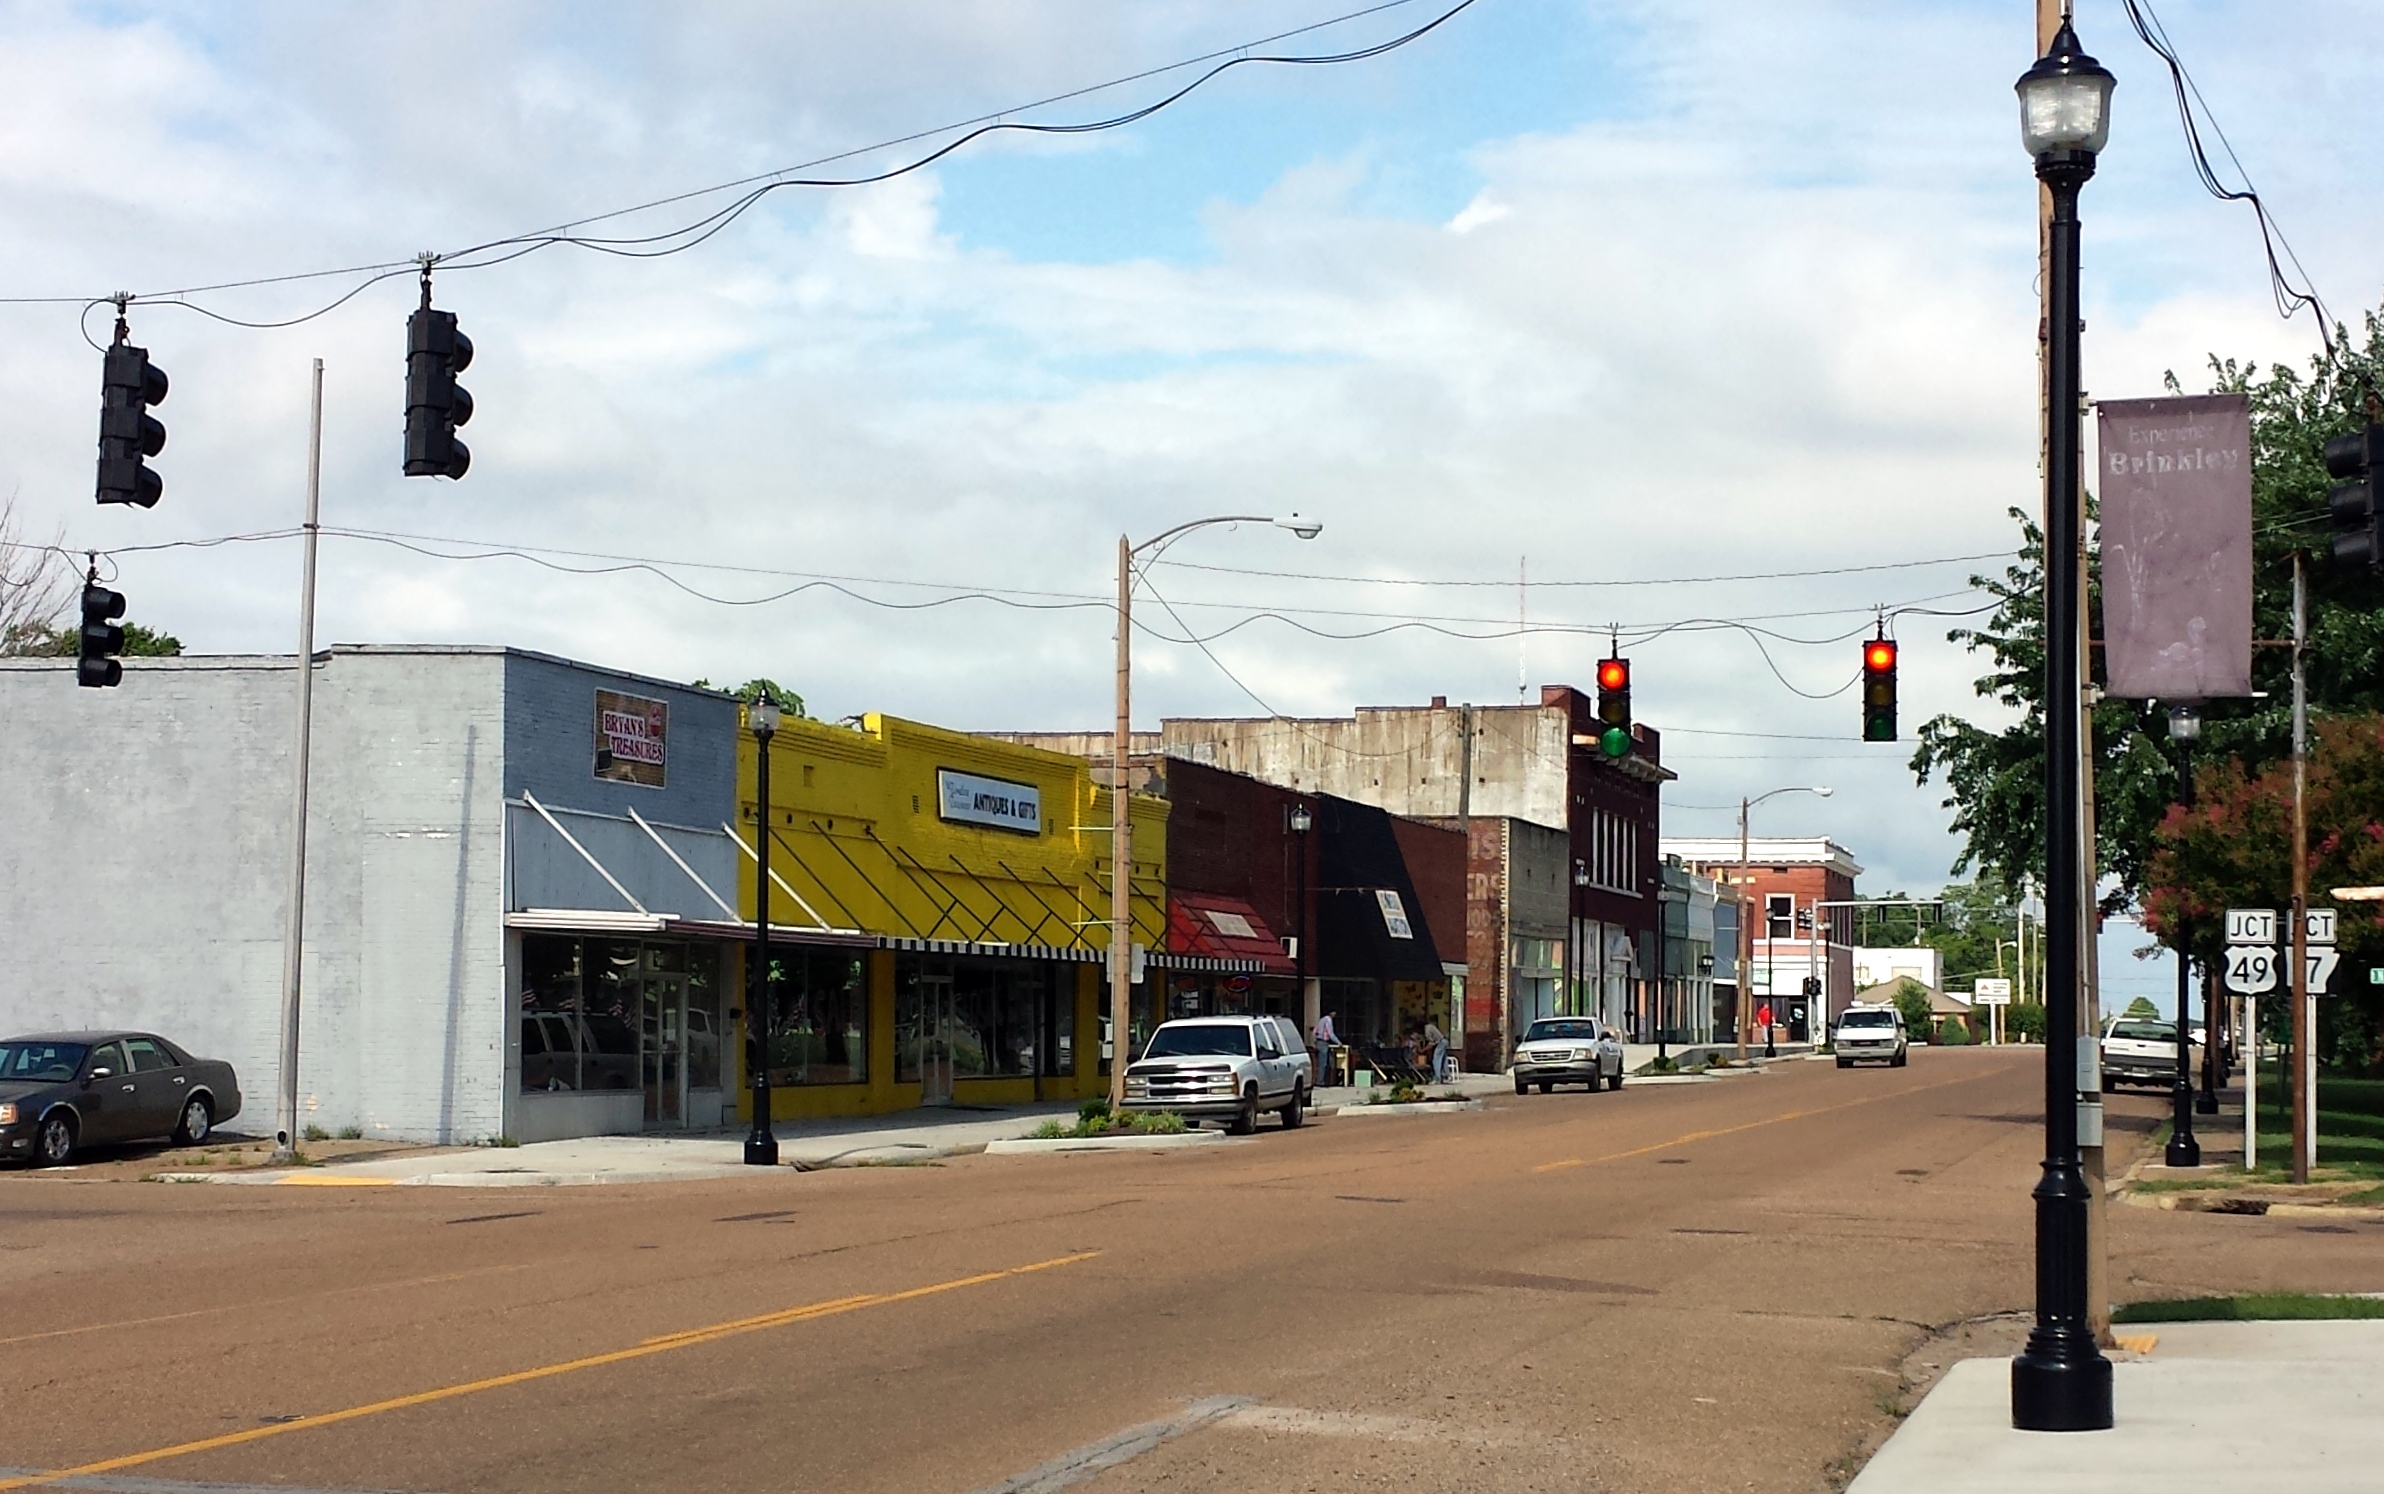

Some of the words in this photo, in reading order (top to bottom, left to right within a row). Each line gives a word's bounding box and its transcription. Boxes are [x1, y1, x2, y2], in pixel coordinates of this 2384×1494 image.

[2107, 447, 2238, 475] Brinkley
[604, 713, 644, 738] BRYAN'S
[611, 735, 663, 763] TREASURES
[973, 792, 1009, 816] ANTIQUES
[2230, 915, 2272, 937] JCT
[2291, 915, 2333, 937] CT
[2231, 956, 2269, 984] 49
